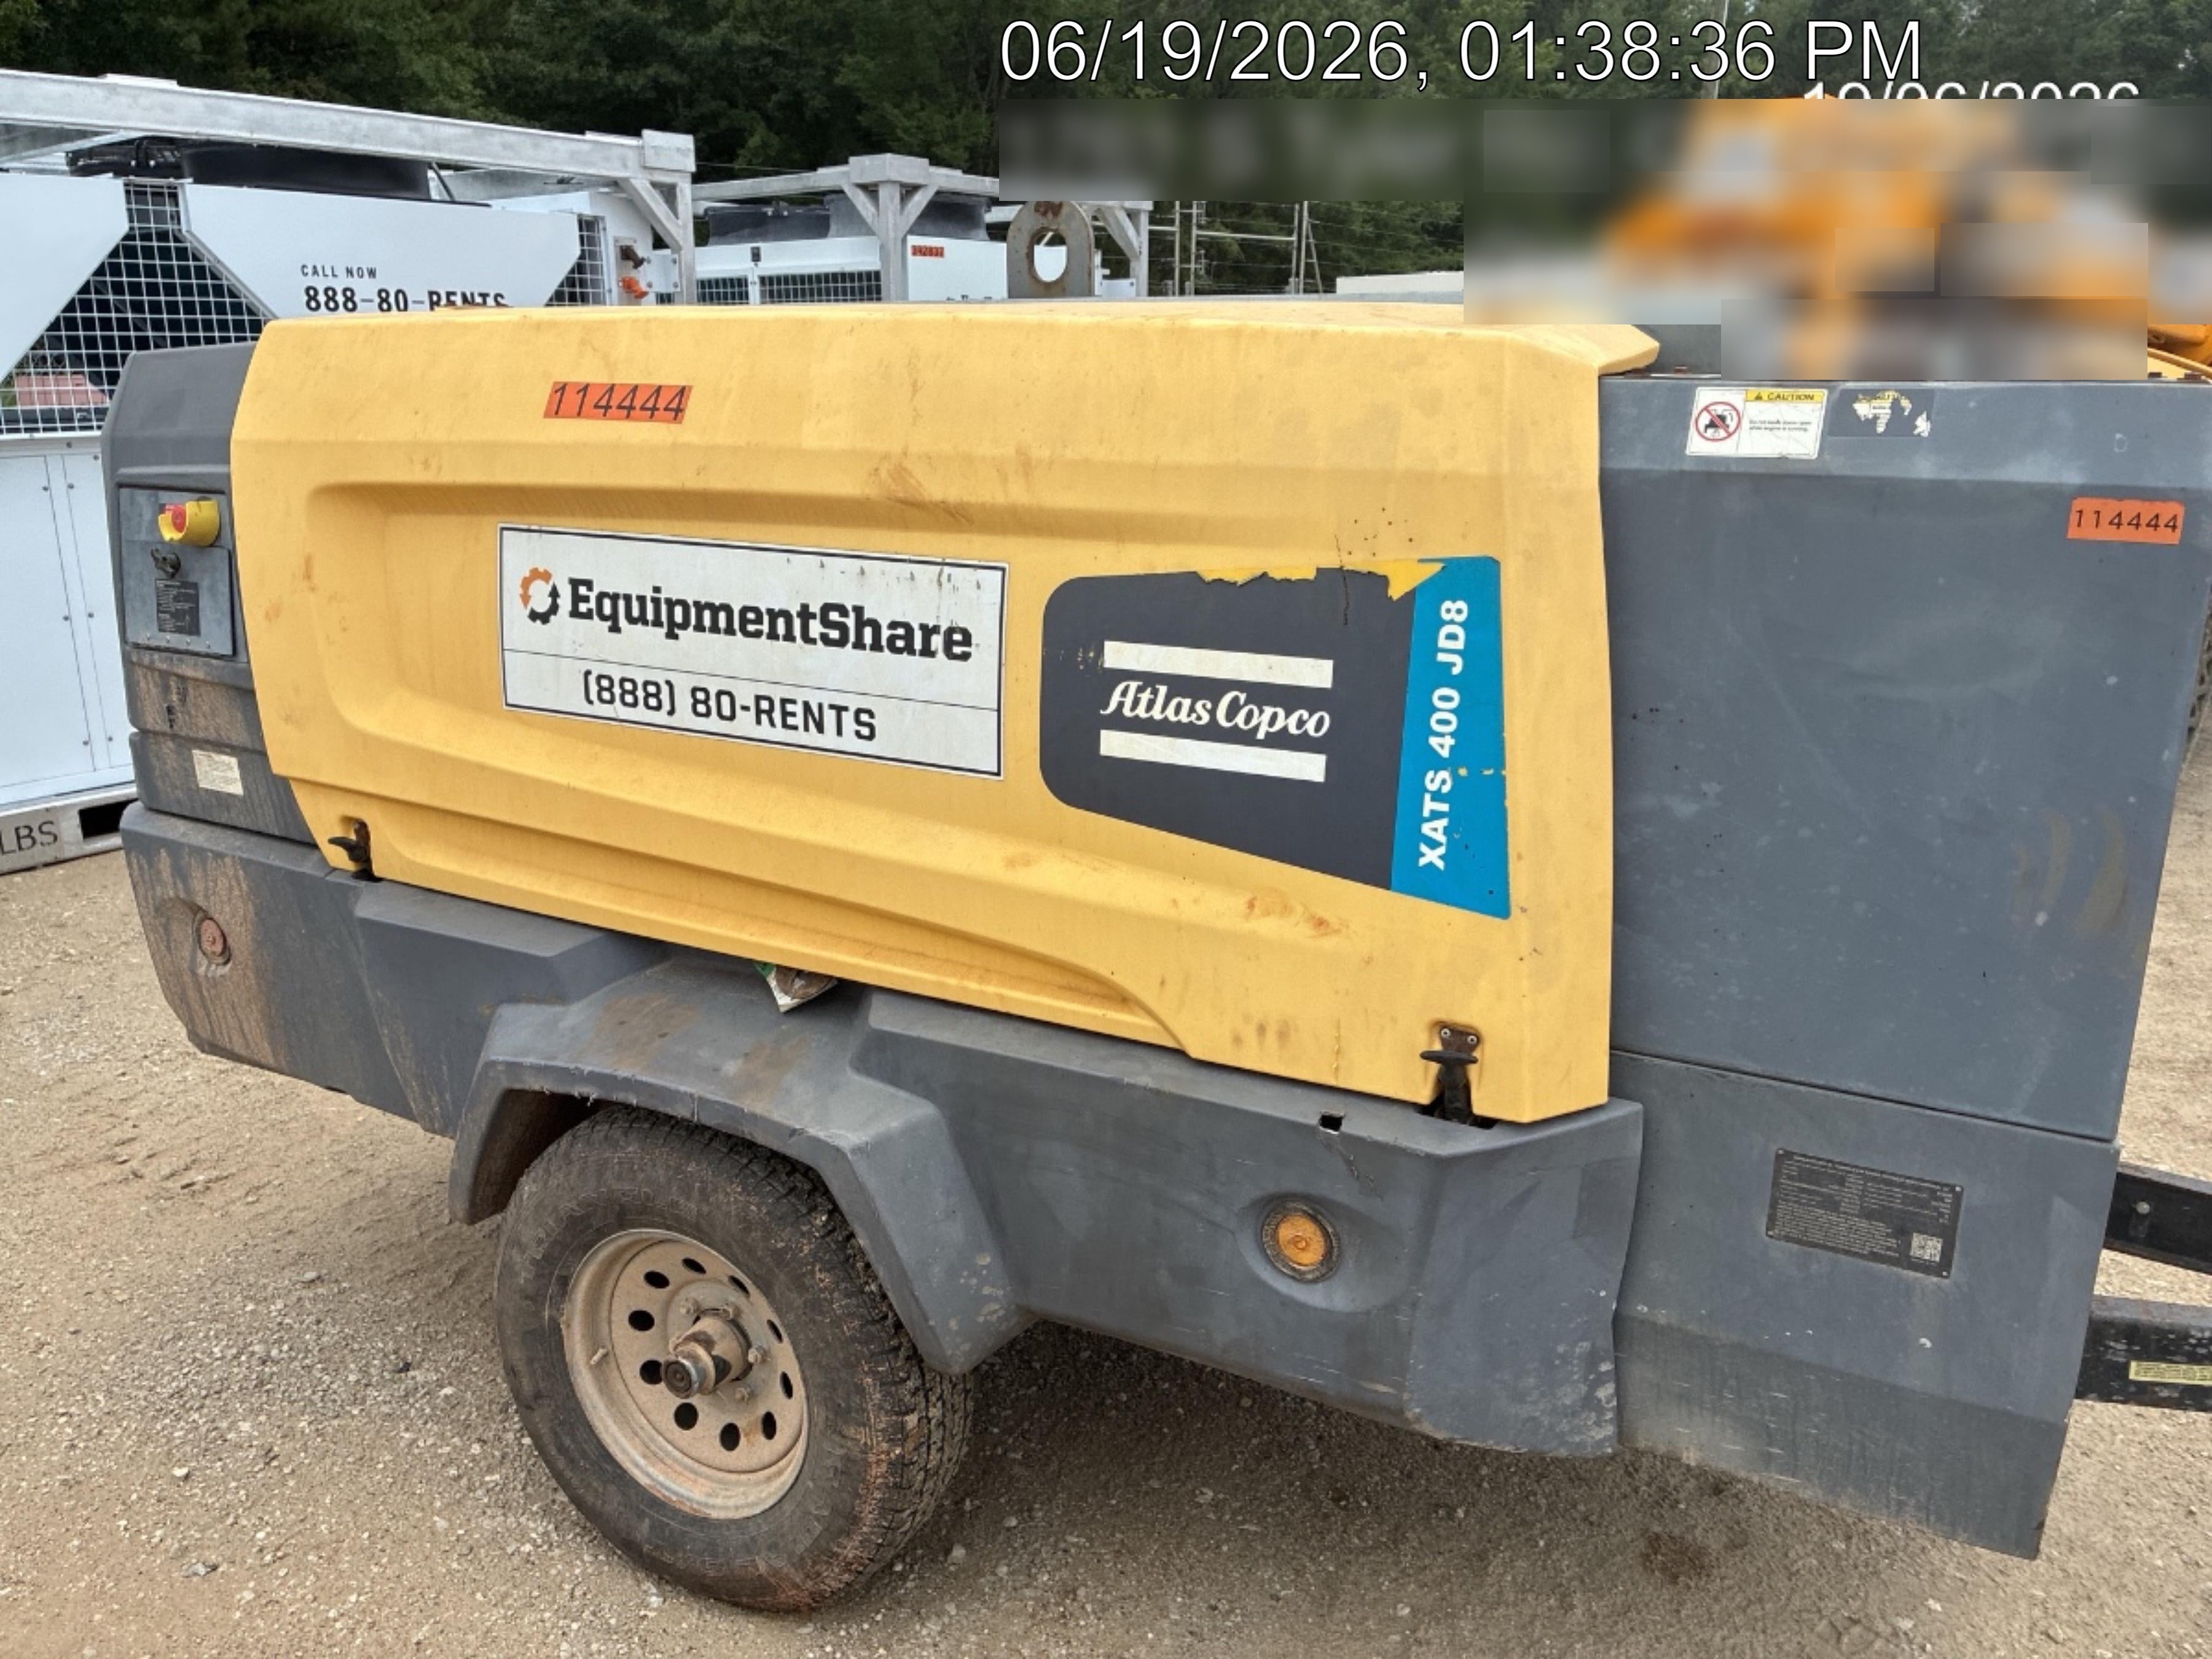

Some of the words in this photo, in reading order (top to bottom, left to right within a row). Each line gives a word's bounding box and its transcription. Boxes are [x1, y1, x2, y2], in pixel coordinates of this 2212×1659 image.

[300, 264, 339, 278] CALL
[346, 266, 377, 278] NOW
[554, 383, 687, 421] 114444
[1767, 392, 1814, 401] CAUTION
[2076, 509, 2178, 533] 114444
[568, 578, 973, 662] EquipmentShare
[1437, 600, 1469, 676] JD8
[583, 669, 676, 716] (888)
[691, 686, 877, 742] 80-RENTS
[1100, 680, 1213, 726] Atlas
[1215, 690, 1331, 740] Copco
[1429, 687, 1461, 758] 400
[1418, 770, 1452, 871] XATS
